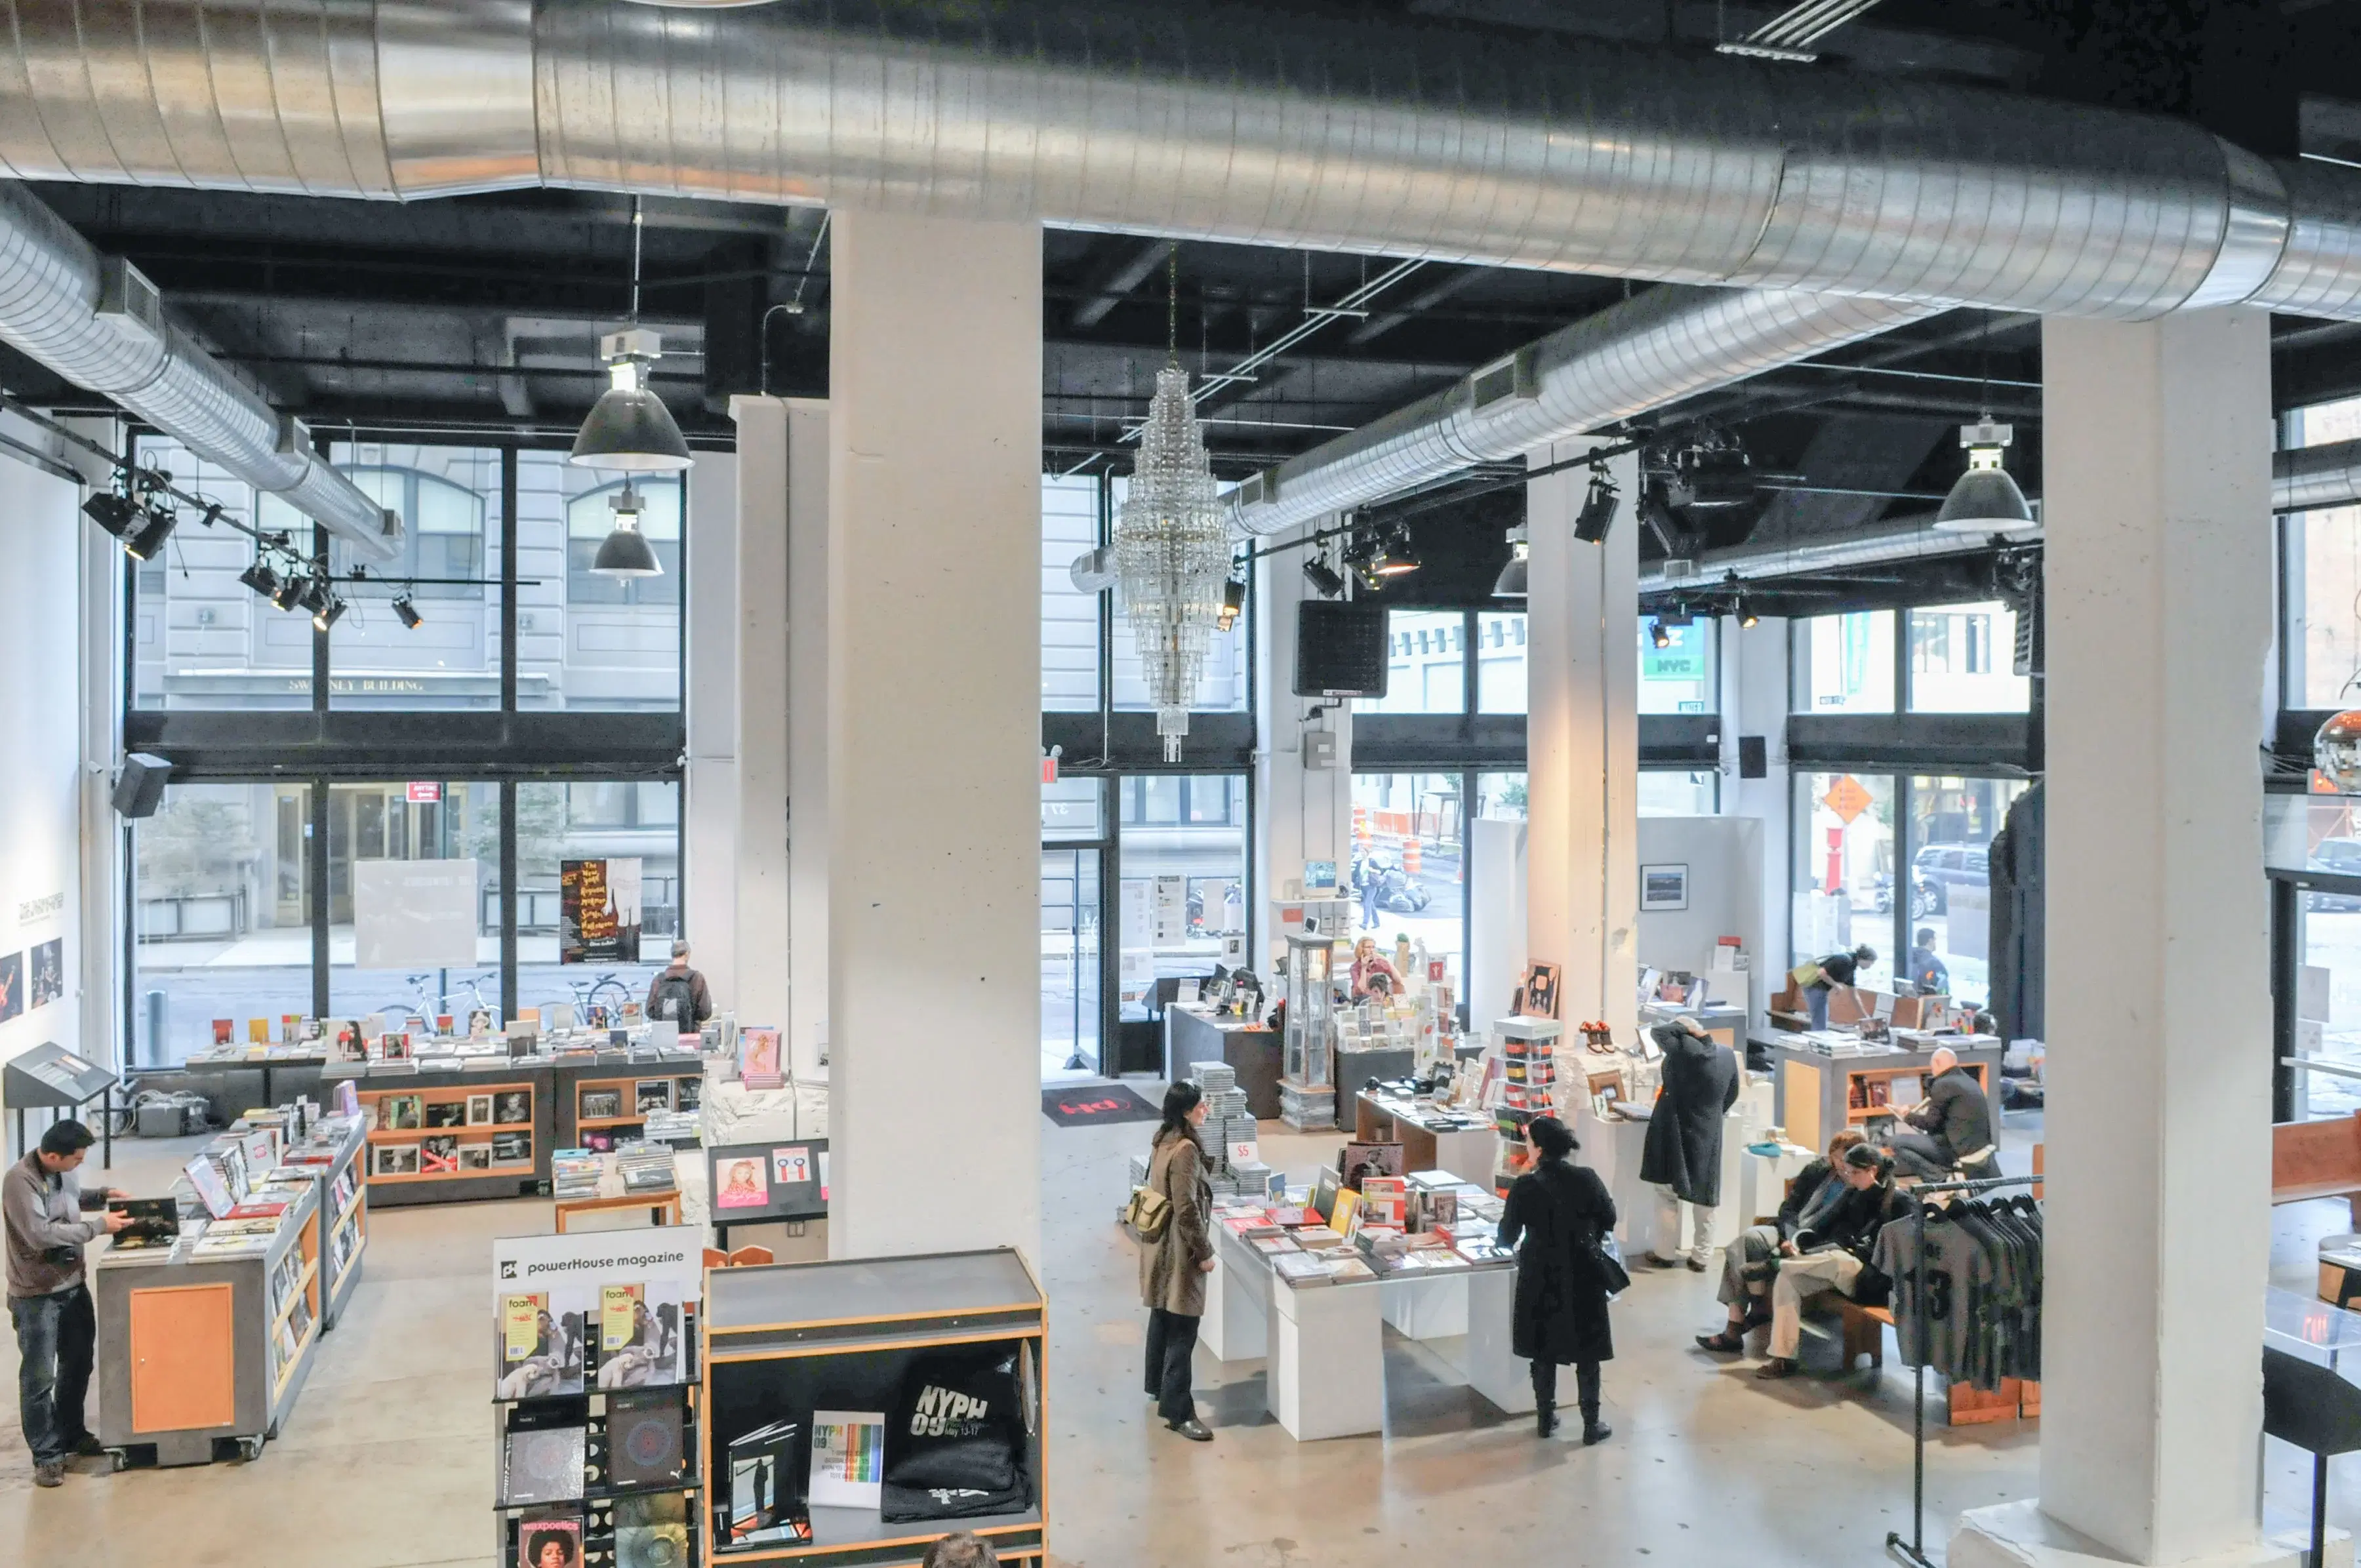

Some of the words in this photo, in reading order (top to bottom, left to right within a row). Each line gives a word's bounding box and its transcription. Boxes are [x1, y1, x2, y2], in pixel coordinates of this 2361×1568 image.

[1657, 659, 1691, 672] NYC
[289, 679, 354, 691] SWNEY
[363, 679, 424, 691] BUILDING
[1238, 1144, 1249, 1157] $5
[527, 1258, 614, 1276] powerHouse
[616, 1251, 684, 1267] magazine
[916, 1384, 988, 1419] NYPH
[813, 1424, 843, 1437] NYPH
[910, 1413, 947, 1437] 09
[813, 1437, 827, 1449] 09
[521, 1520, 580, 1532] waxpoetics
